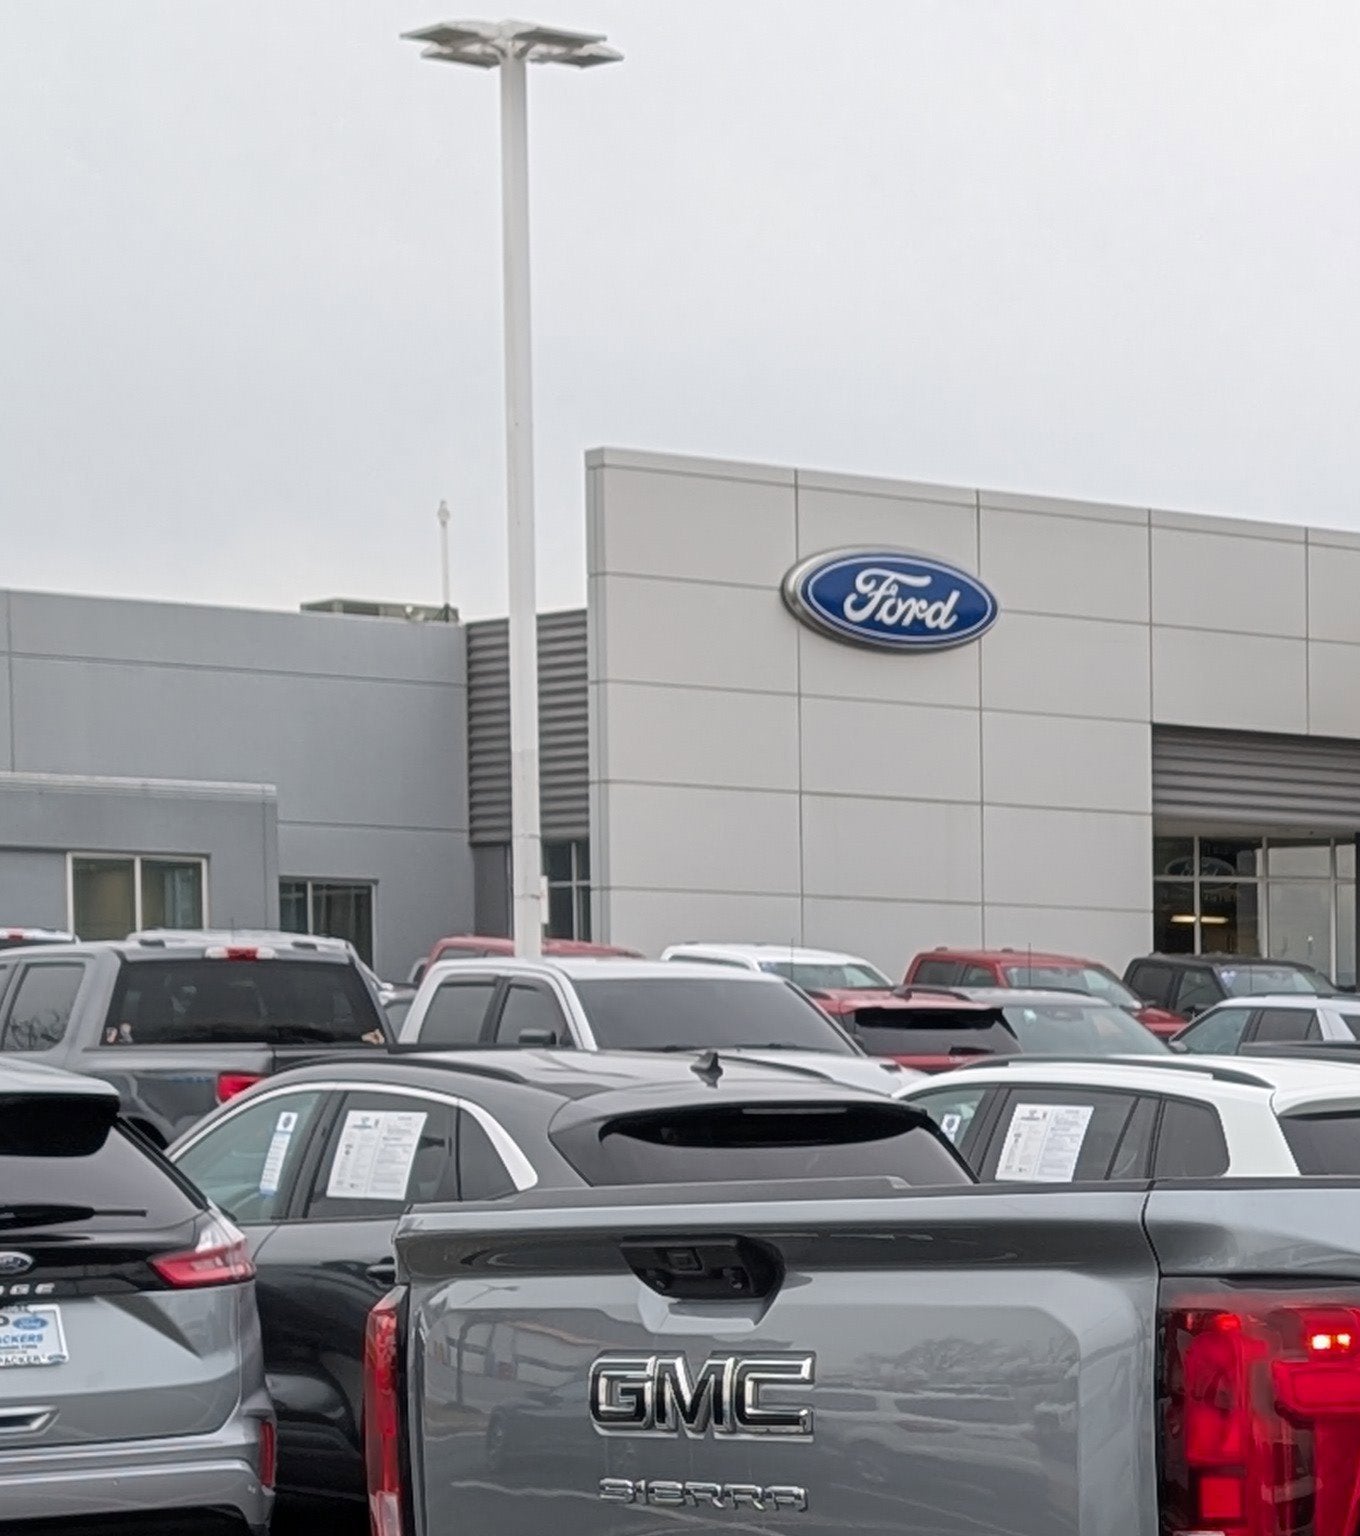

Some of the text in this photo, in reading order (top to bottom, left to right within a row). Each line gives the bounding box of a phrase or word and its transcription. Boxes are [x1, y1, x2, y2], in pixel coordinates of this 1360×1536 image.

[843, 567, 959, 630] Ford
[0, 1282, 55, 1295] GE
[0, 1334, 43, 1344] CKERS
[588, 1351, 816, 1436] GMC
[600, 1477, 808, 1511] SIERRA
